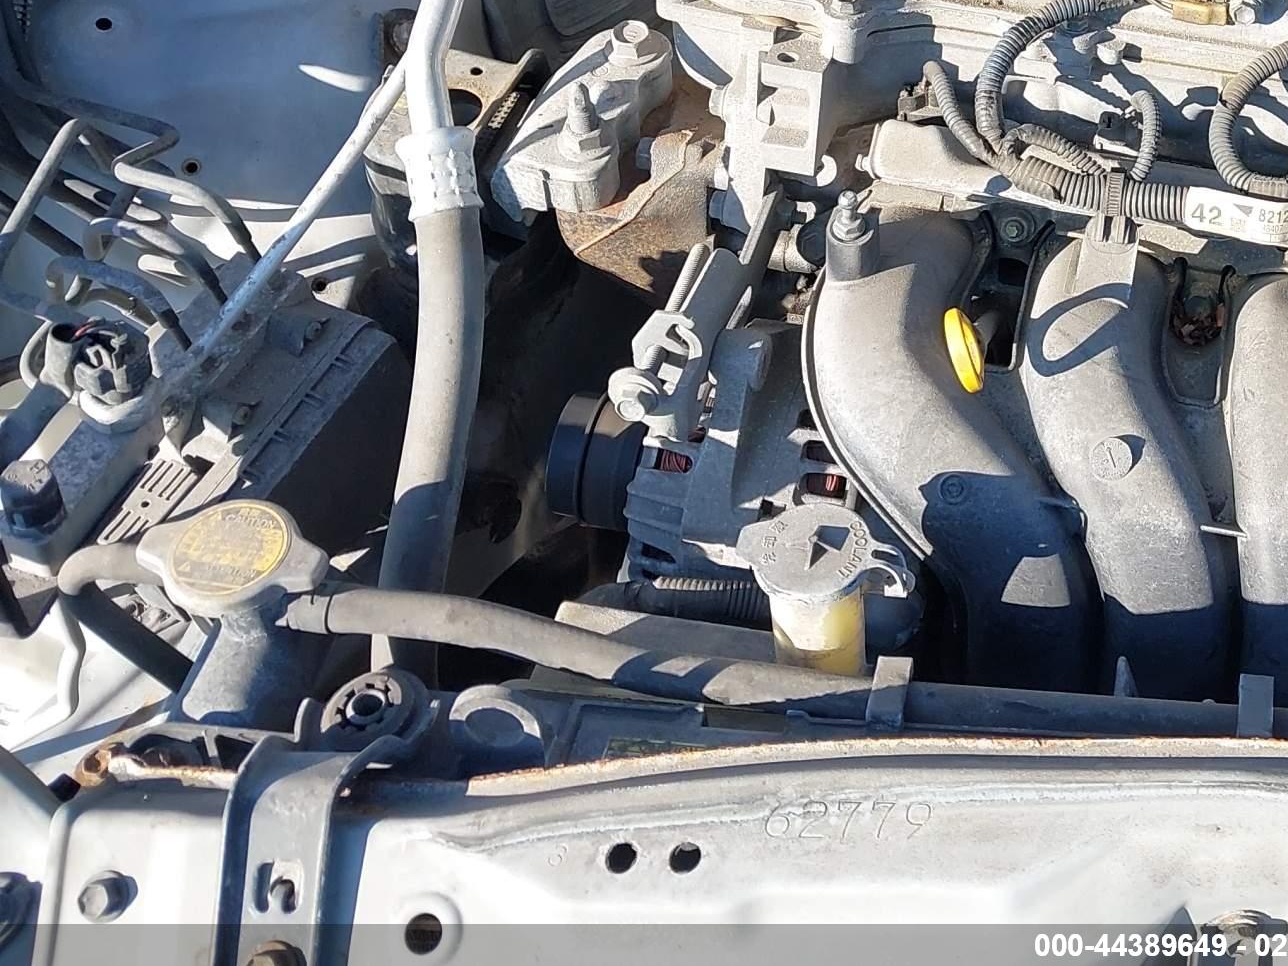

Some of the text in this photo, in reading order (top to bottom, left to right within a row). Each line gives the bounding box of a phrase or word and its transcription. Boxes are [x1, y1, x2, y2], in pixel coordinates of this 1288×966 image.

[1191, 203, 1223, 226] 42
[224, 514, 277, 530] CAUTION
[837, 519, 868, 580] COOLANT
[764, 798, 933, 843] 62779
